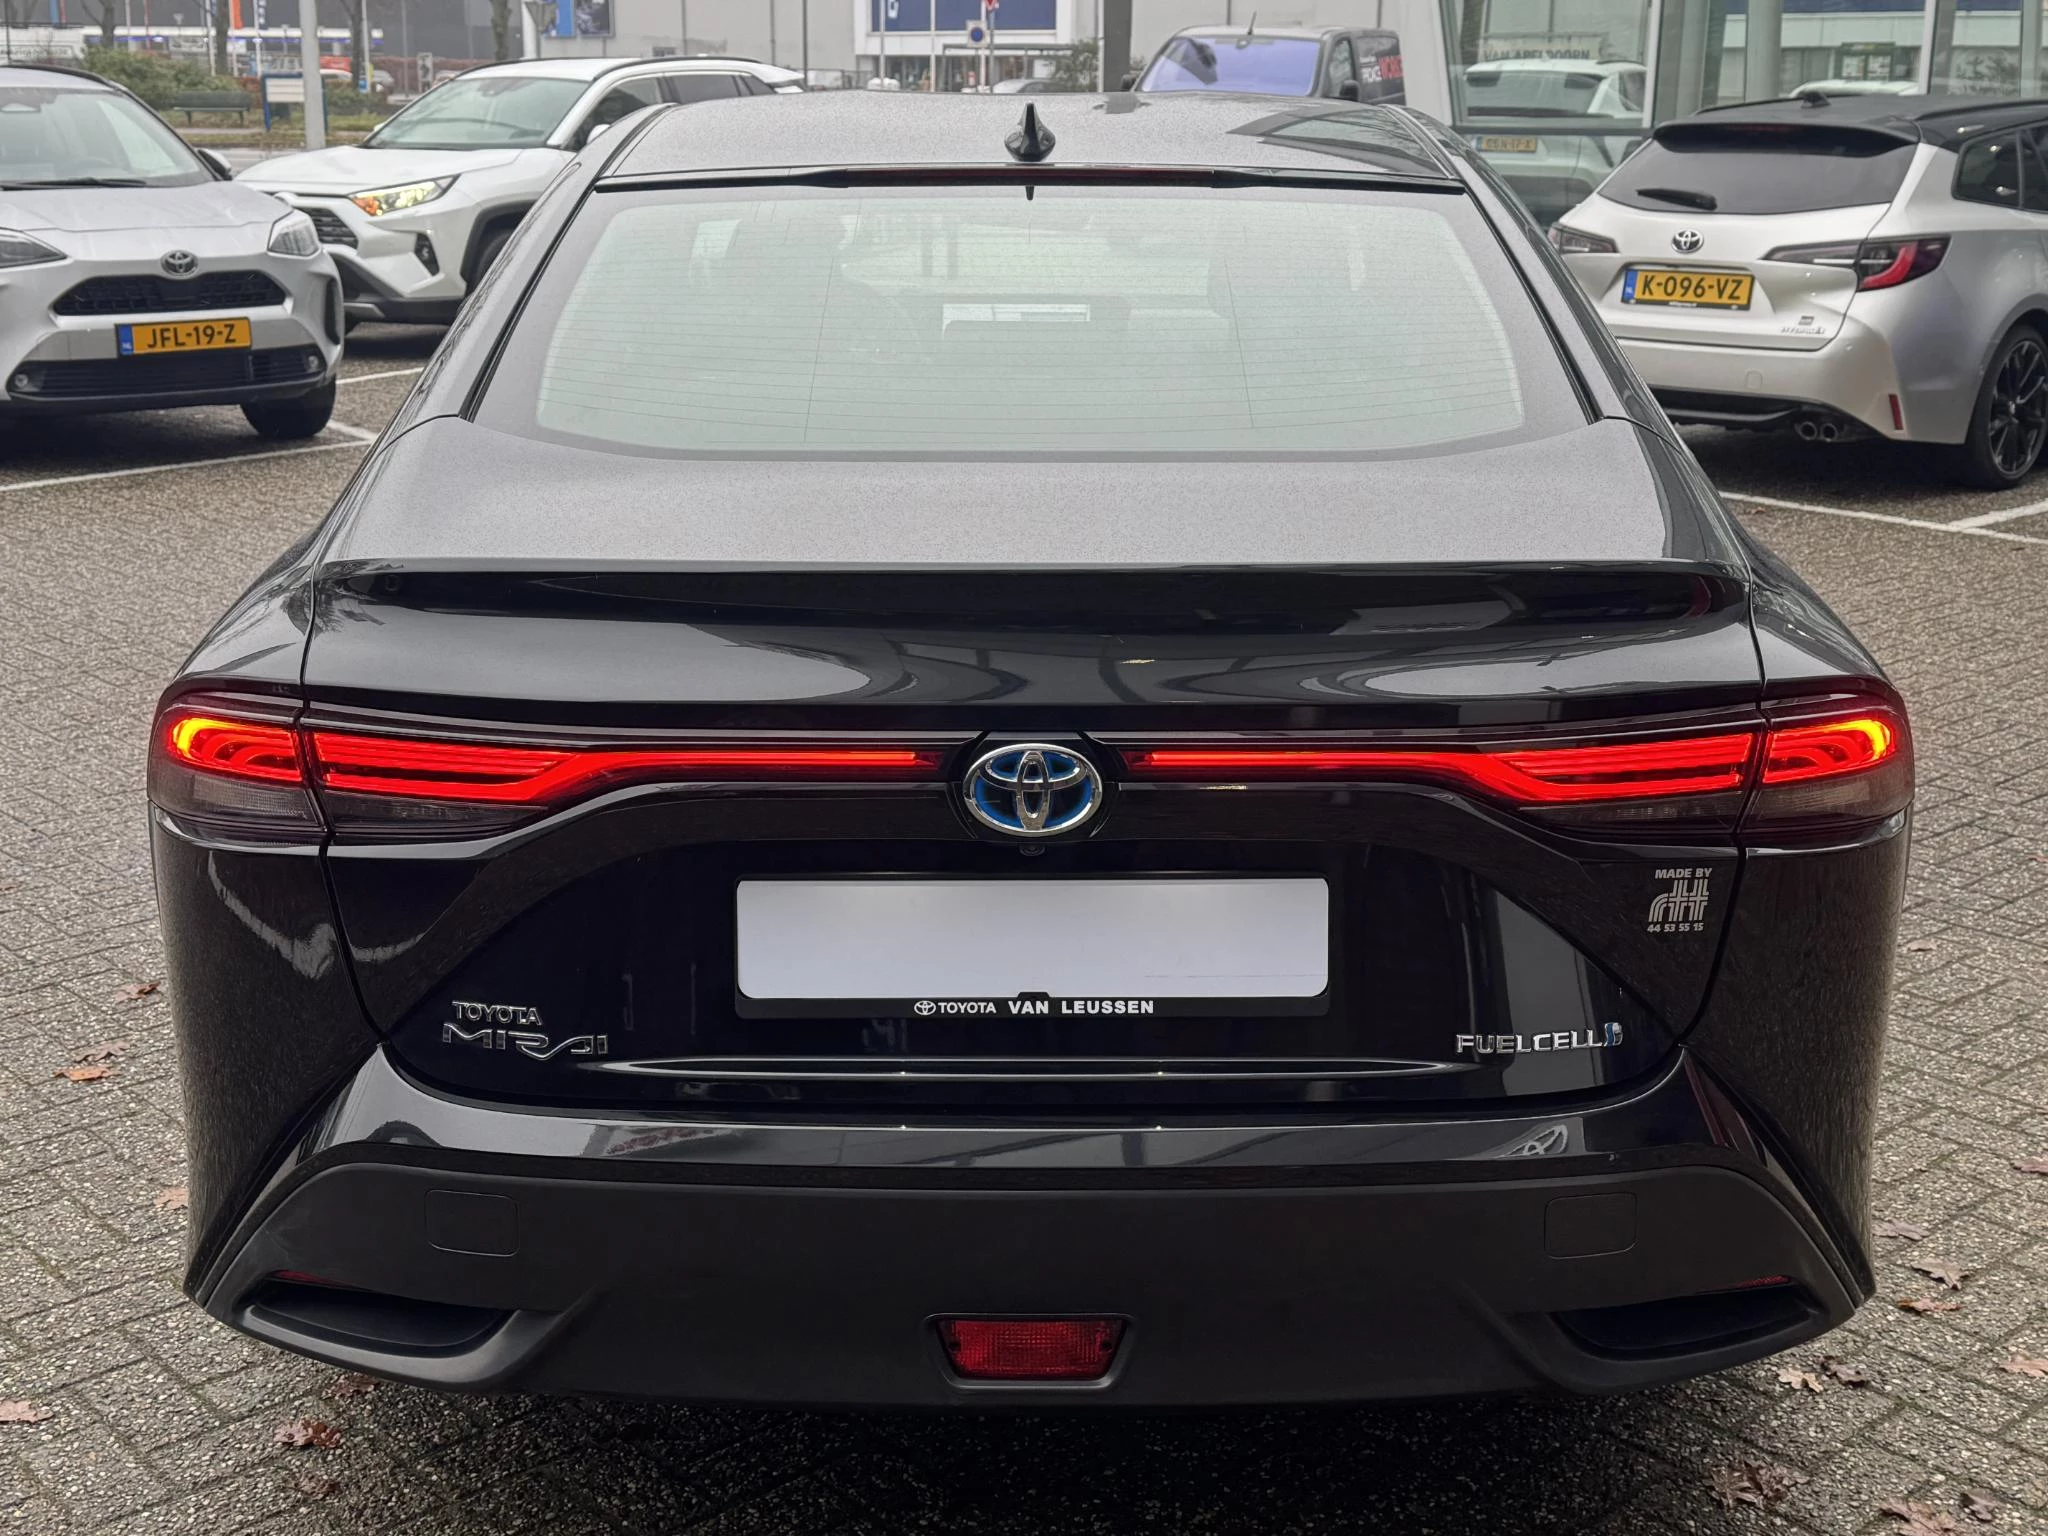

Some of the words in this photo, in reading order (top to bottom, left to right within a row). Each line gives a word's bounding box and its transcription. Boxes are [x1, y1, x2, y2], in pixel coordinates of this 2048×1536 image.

[1642, 275, 1744, 300] K-096-VZ
[147, 323, 237, 348] JFL-19-Z
[1655, 868, 1693, 879] MADE
[1695, 867, 1713, 878] BY
[1647, 924, 1661, 933] 44
[1664, 923, 1676, 932] 53
[1678, 923, 1690, 932] 55
[1692, 922, 1704, 931] 15
[452, 1001, 541, 1026] TOYOTA
[938, 1002, 997, 1014] TOYOTA
[1008, 1000, 1049, 1014] VAN
[1061, 1000, 1154, 1014] LEUSSEN
[442, 1023, 608, 1060] MIRAI
